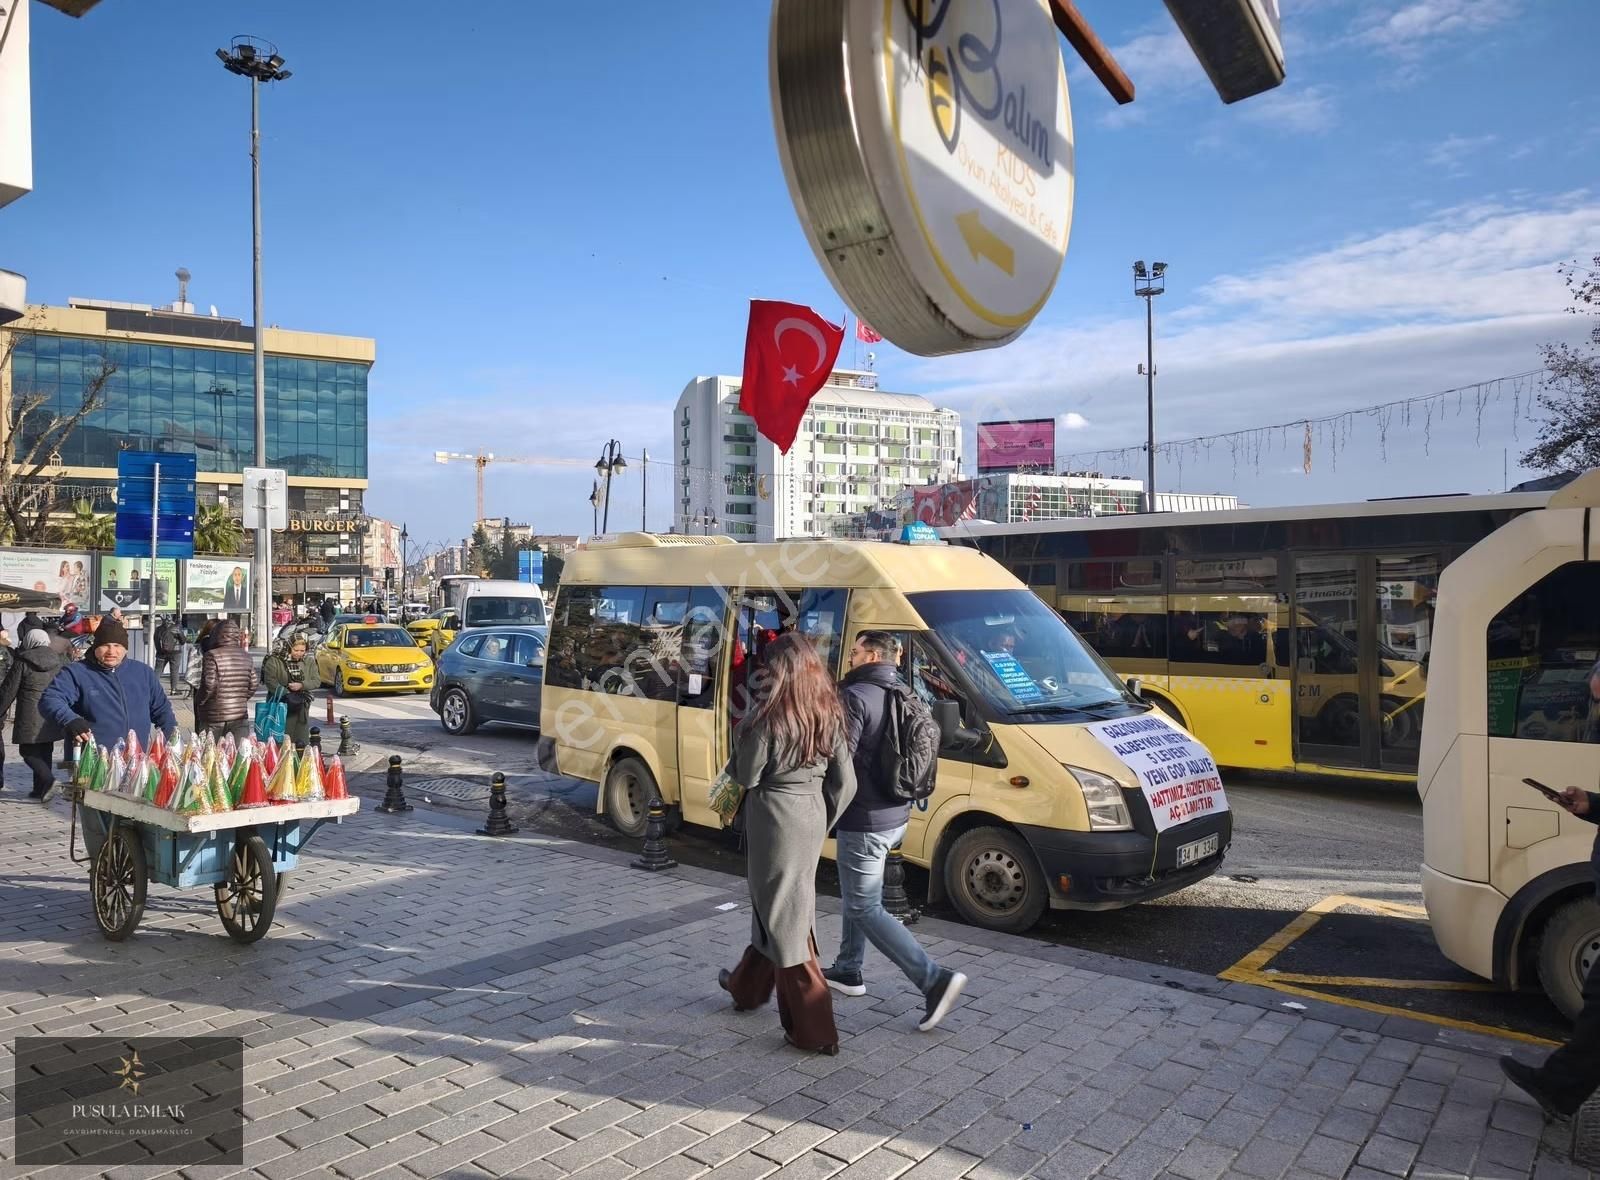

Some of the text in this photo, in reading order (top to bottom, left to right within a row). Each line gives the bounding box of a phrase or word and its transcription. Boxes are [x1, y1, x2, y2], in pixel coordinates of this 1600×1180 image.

[290, 519, 356, 532] BURGER
[1145, 746, 1191, 764] 5 LEVENT
[1183, 848, 1191, 862] 34
[1194, 844, 1199, 859] M
